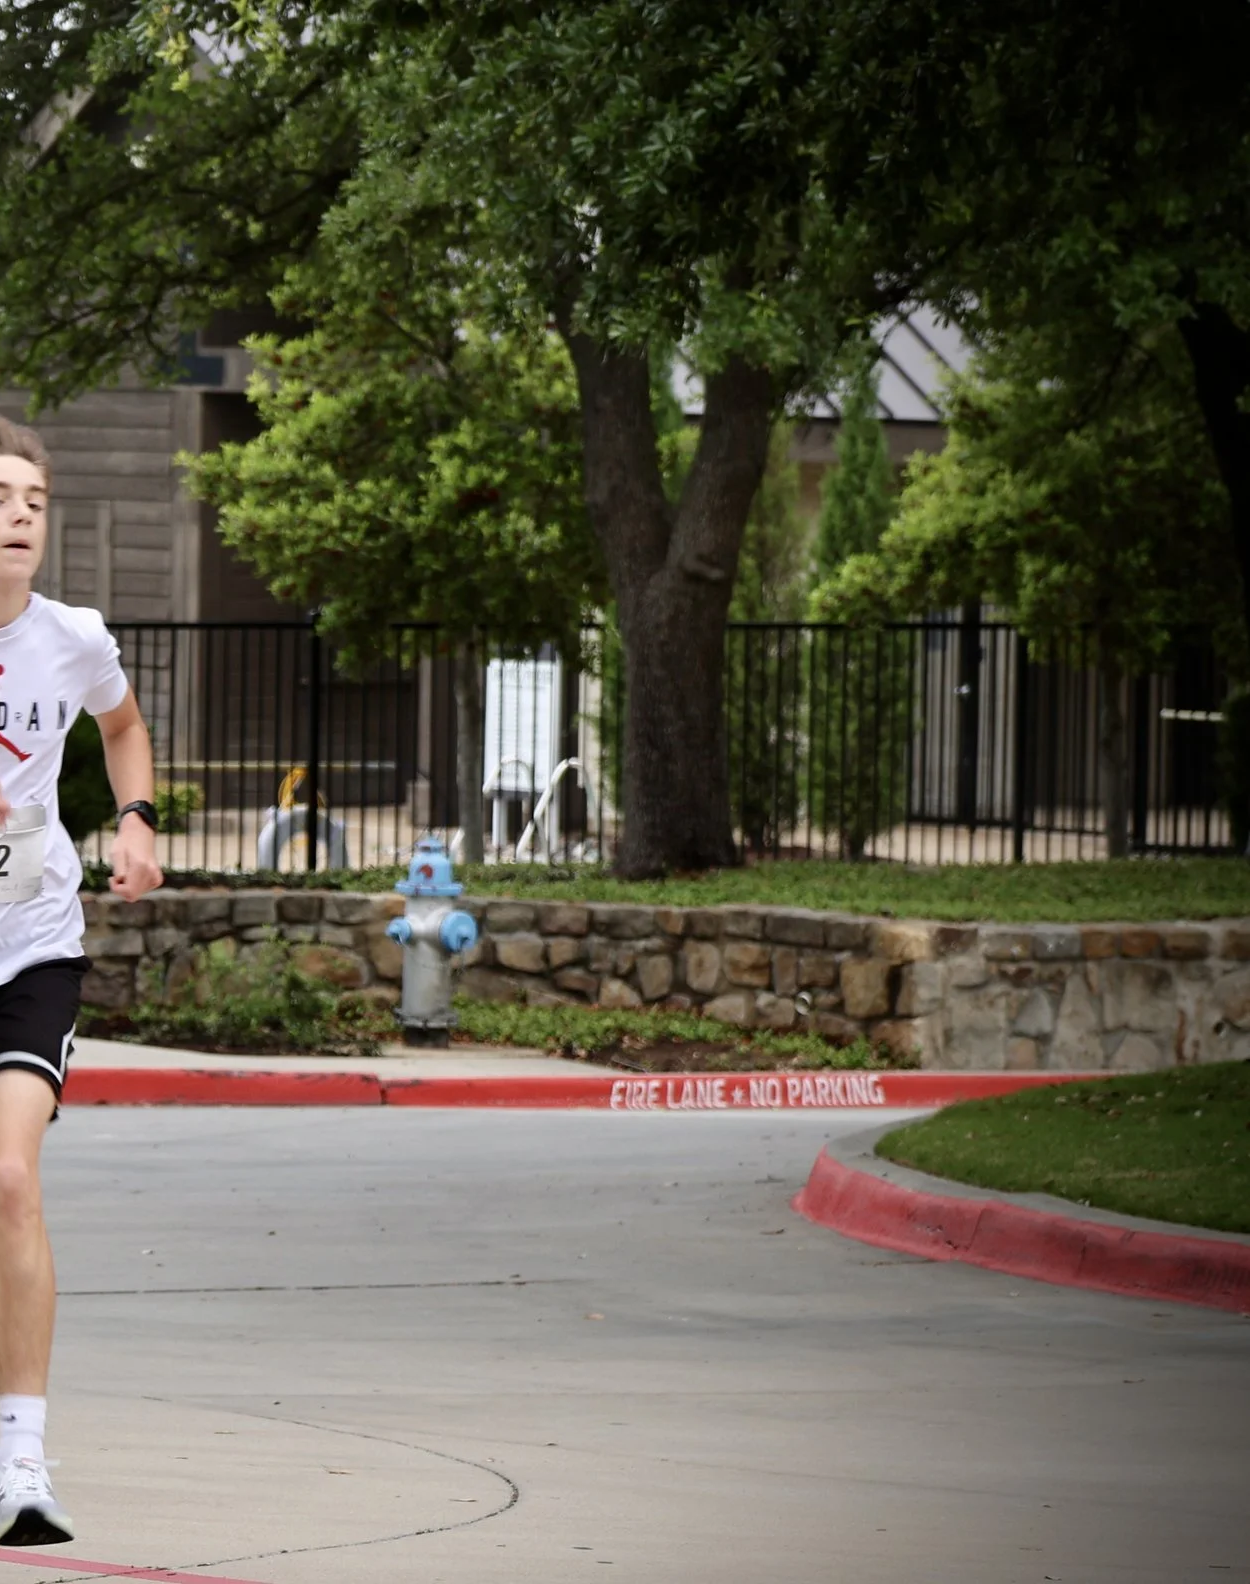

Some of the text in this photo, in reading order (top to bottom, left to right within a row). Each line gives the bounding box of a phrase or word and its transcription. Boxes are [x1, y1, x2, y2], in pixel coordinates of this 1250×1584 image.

[609, 1074, 886, 1111] FIRE LANE NO PARKING
